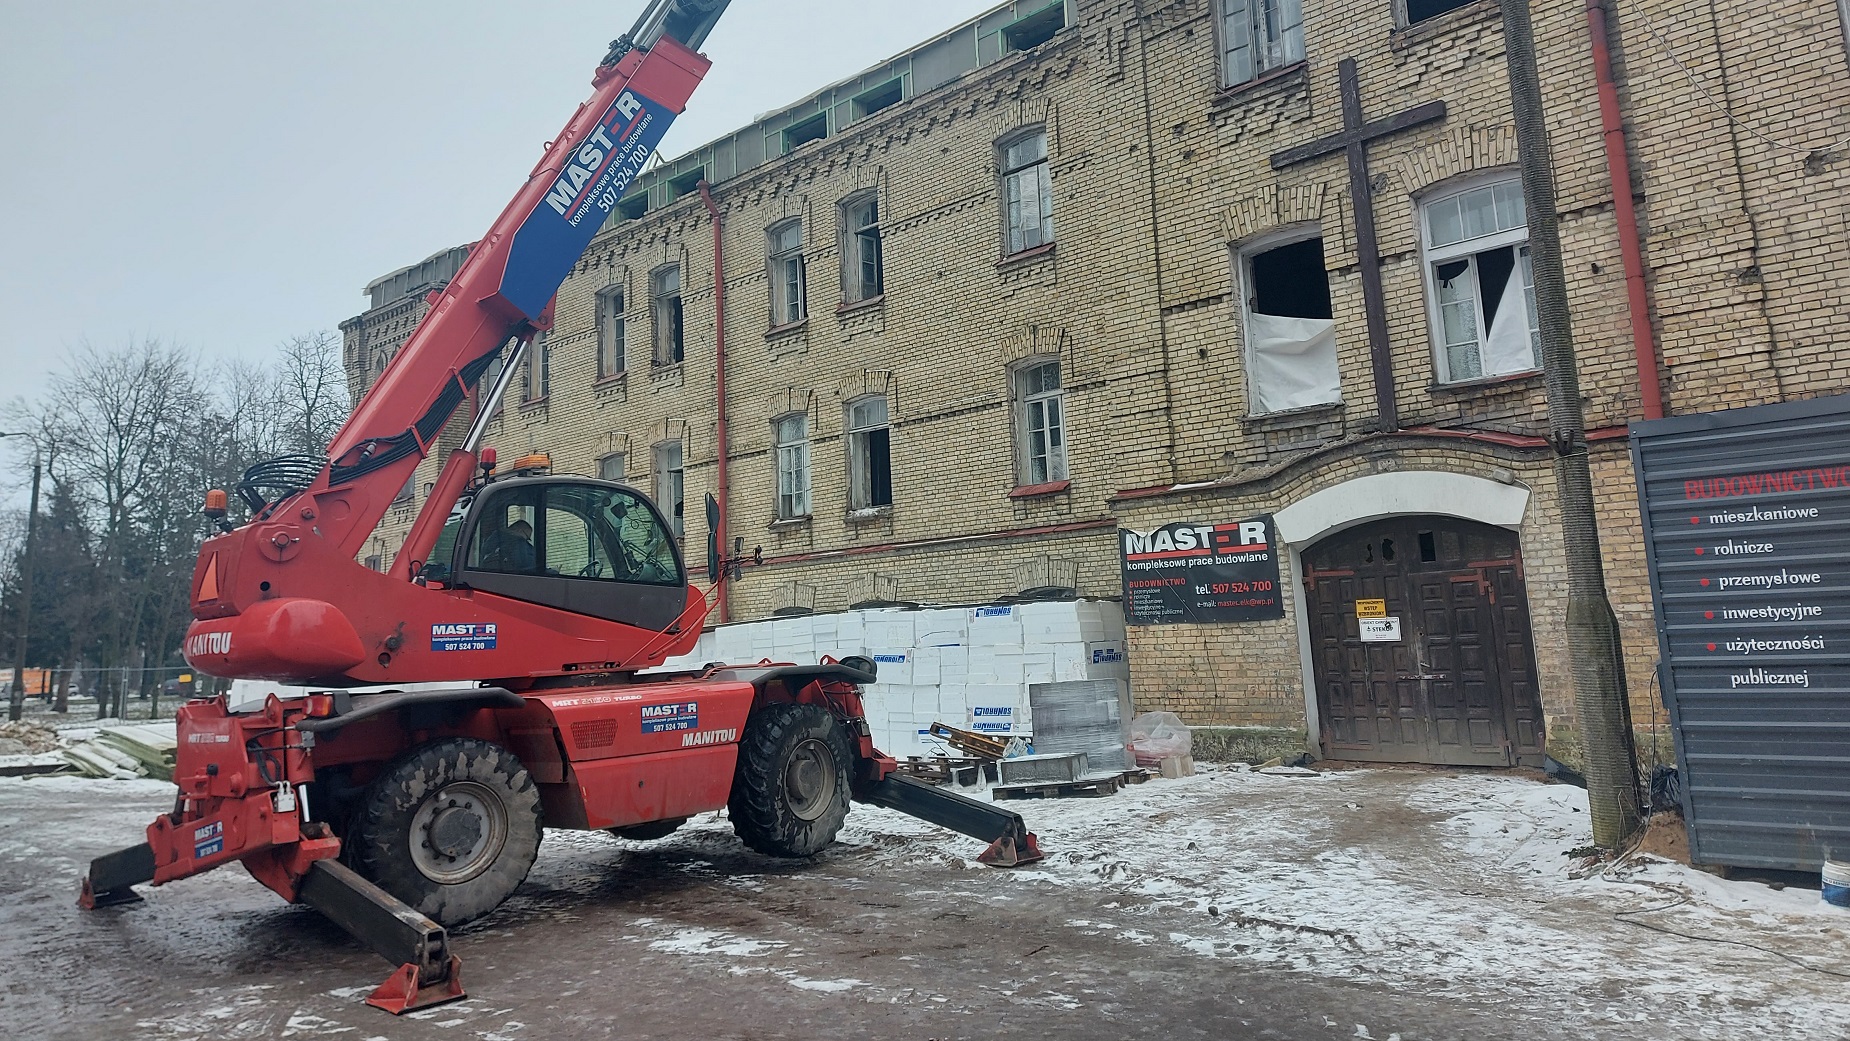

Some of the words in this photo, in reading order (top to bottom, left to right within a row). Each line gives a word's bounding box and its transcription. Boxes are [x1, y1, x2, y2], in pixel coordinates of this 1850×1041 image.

[545, 91, 641, 215] MASTER
[568, 174, 610, 227] kompleksowe
[608, 152, 625, 177] prace
[621, 113, 653, 154] budowlane
[597, 189, 618, 213] 507
[613, 167, 634, 191] 524
[628, 143, 649, 169] 700
[1709, 506, 1819, 524] mieszkaniowe
[1125, 521, 1268, 555] MASTER
[1714, 540, 1774, 556] rolnicze
[1126, 558, 1187, 572] kompleksowe
[1188, 557, 1213, 568] prace
[1215, 552, 1268, 565] budowlane
[1129, 578, 1186, 588] BUDOWNICTWO
[1195, 583, 1211, 595] tel.
[1212, 583, 1229, 594] 507
[1231, 582, 1249, 593] 524
[1251, 580, 1272, 592] 700
[1719, 568, 1821, 590] przemysłowe
[1196, 600, 1217, 608] e-mail:
[1722, 603, 1822, 621] inwestycyjne
[432, 624, 496, 635] MASTER
[444, 643, 457, 651] 507
[472, 642, 485, 650] 700
[1726, 635, 1825, 655] użyteczności
[1731, 668, 1809, 688] publicznej
[551, 698, 580, 707] MRT
[641, 703, 697, 718] MASTER
[653, 724, 664, 732] 507
[665, 723, 676, 731] 524
[677, 722, 688, 730] 700
[681, 728, 736, 747] MANITOU
